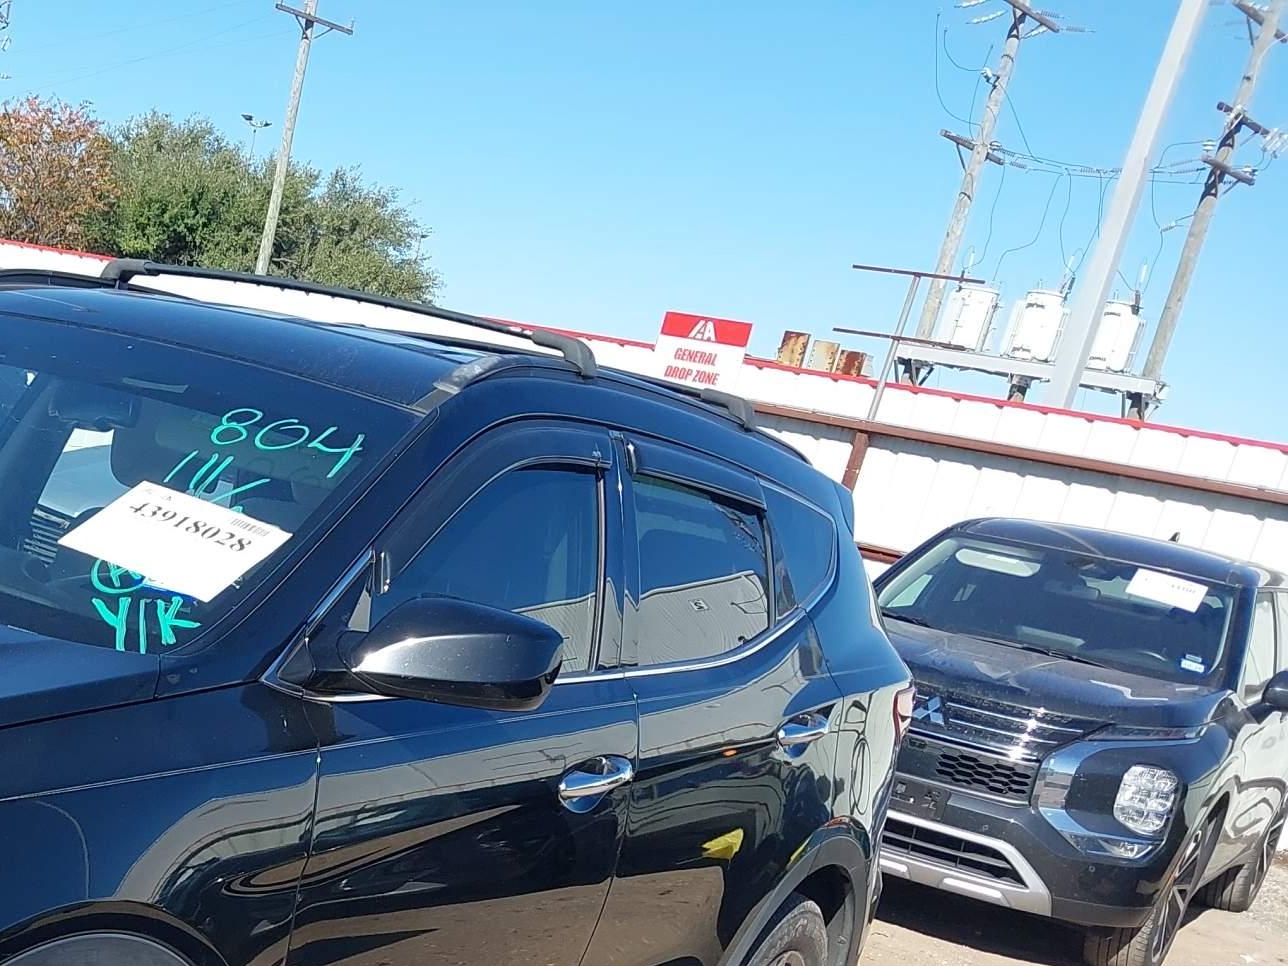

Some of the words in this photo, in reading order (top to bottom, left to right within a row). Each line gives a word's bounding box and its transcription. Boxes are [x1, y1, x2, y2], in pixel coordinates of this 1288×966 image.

[674, 347, 718, 366] GENERAL
[664, 365, 693, 381] DROP
[692, 369, 720, 386] ZONE
[211, 408, 365, 478] 804
[129, 501, 252, 552] 43918028
